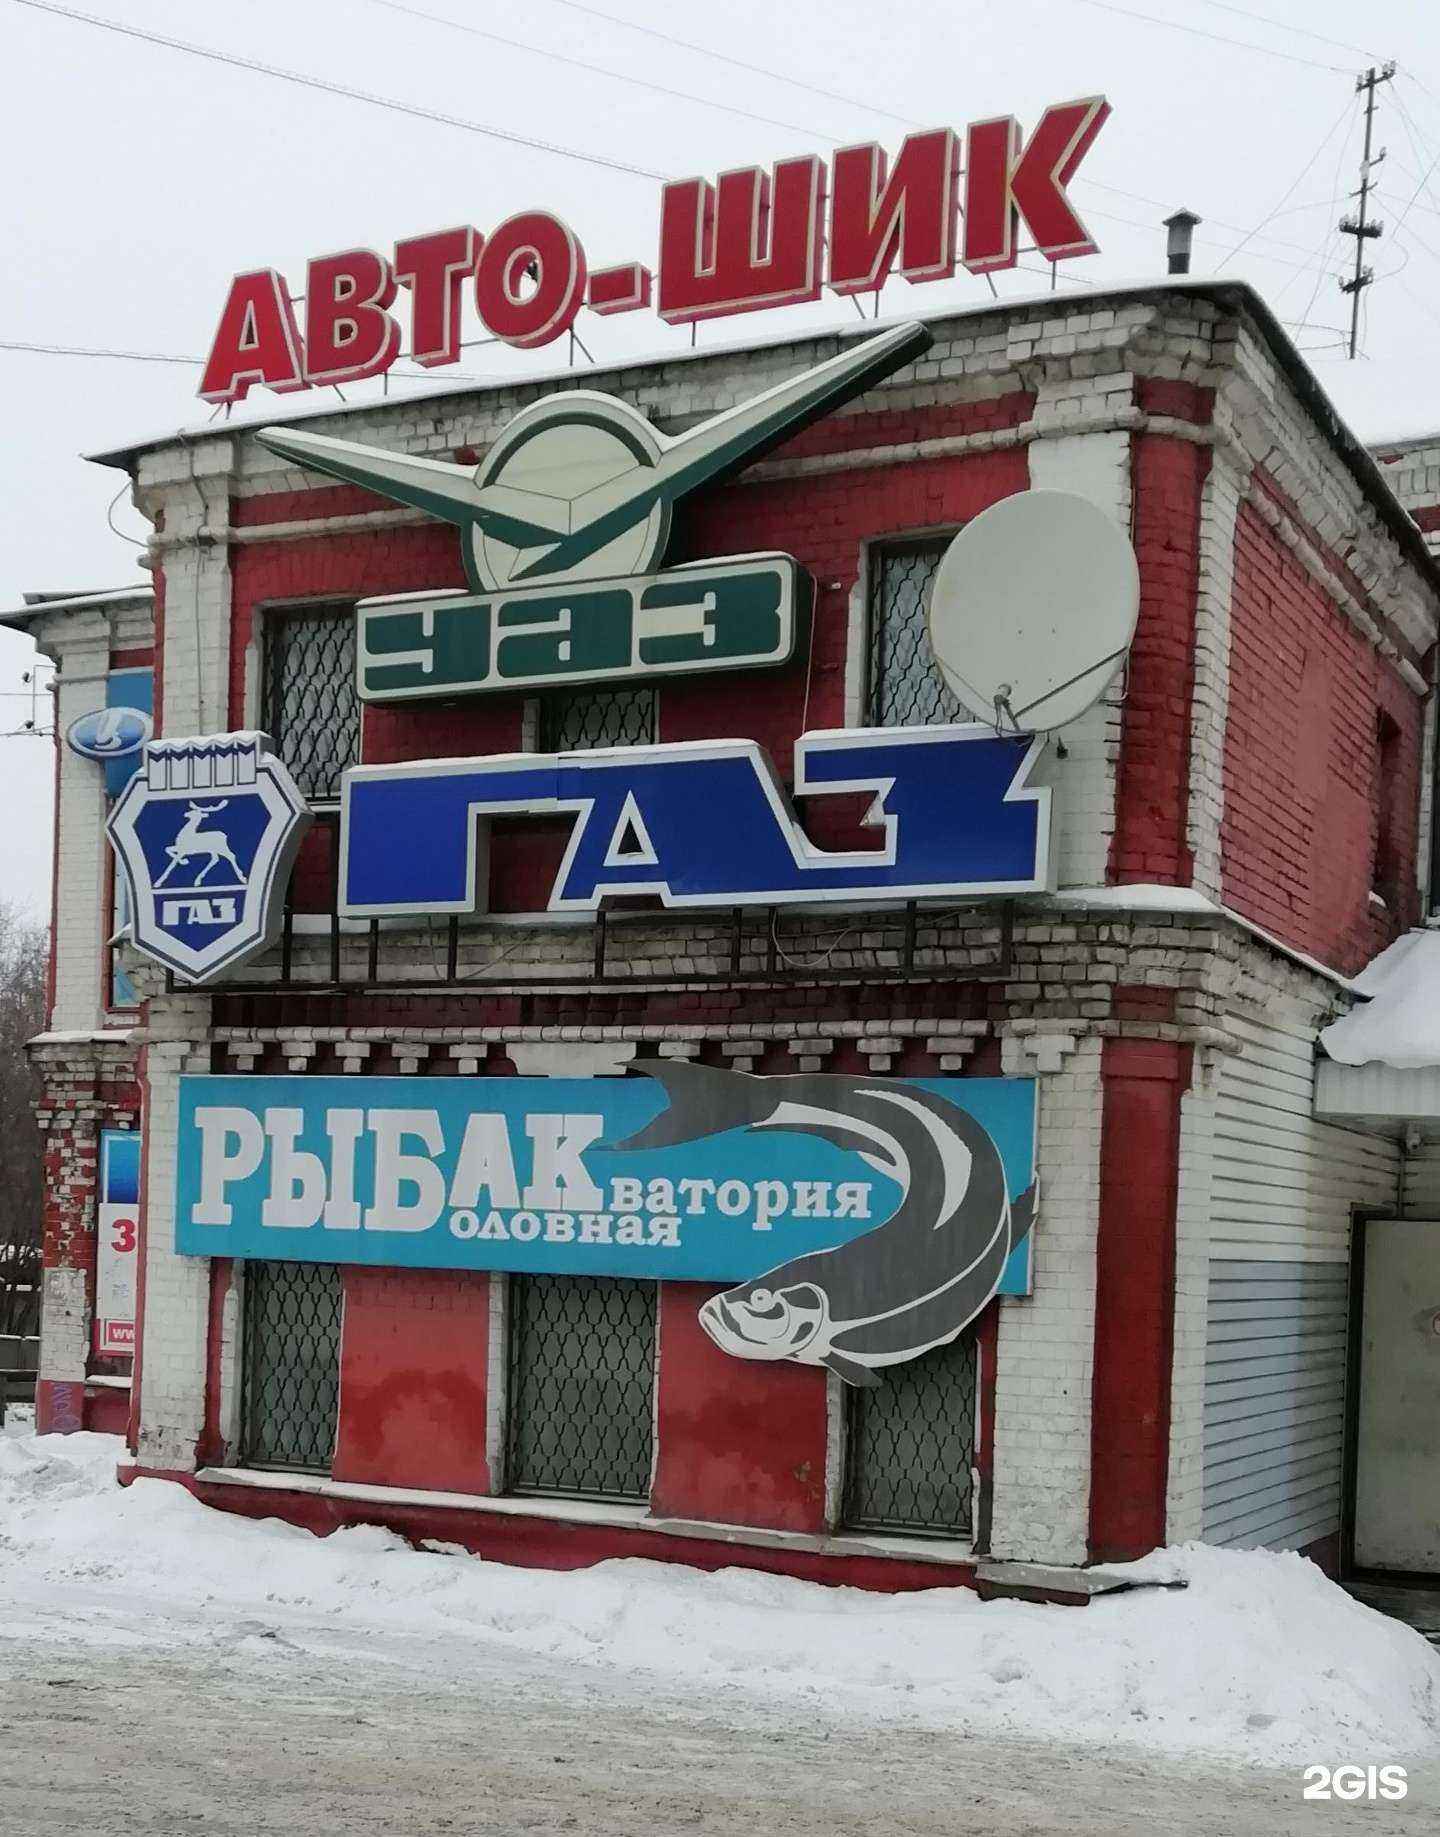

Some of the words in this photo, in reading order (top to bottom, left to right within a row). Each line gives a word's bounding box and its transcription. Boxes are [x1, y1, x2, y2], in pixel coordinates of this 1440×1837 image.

[198, 95, 1113, 402] АВТО-ШИК
[338, 722, 1052, 917] ГАЗ
[162, 897, 236, 925] ГАЗ
[192, 1108, 605, 1233] РЫБАК
[609, 1176, 873, 1231] ватория
[449, 1210, 682, 1247] оловная
